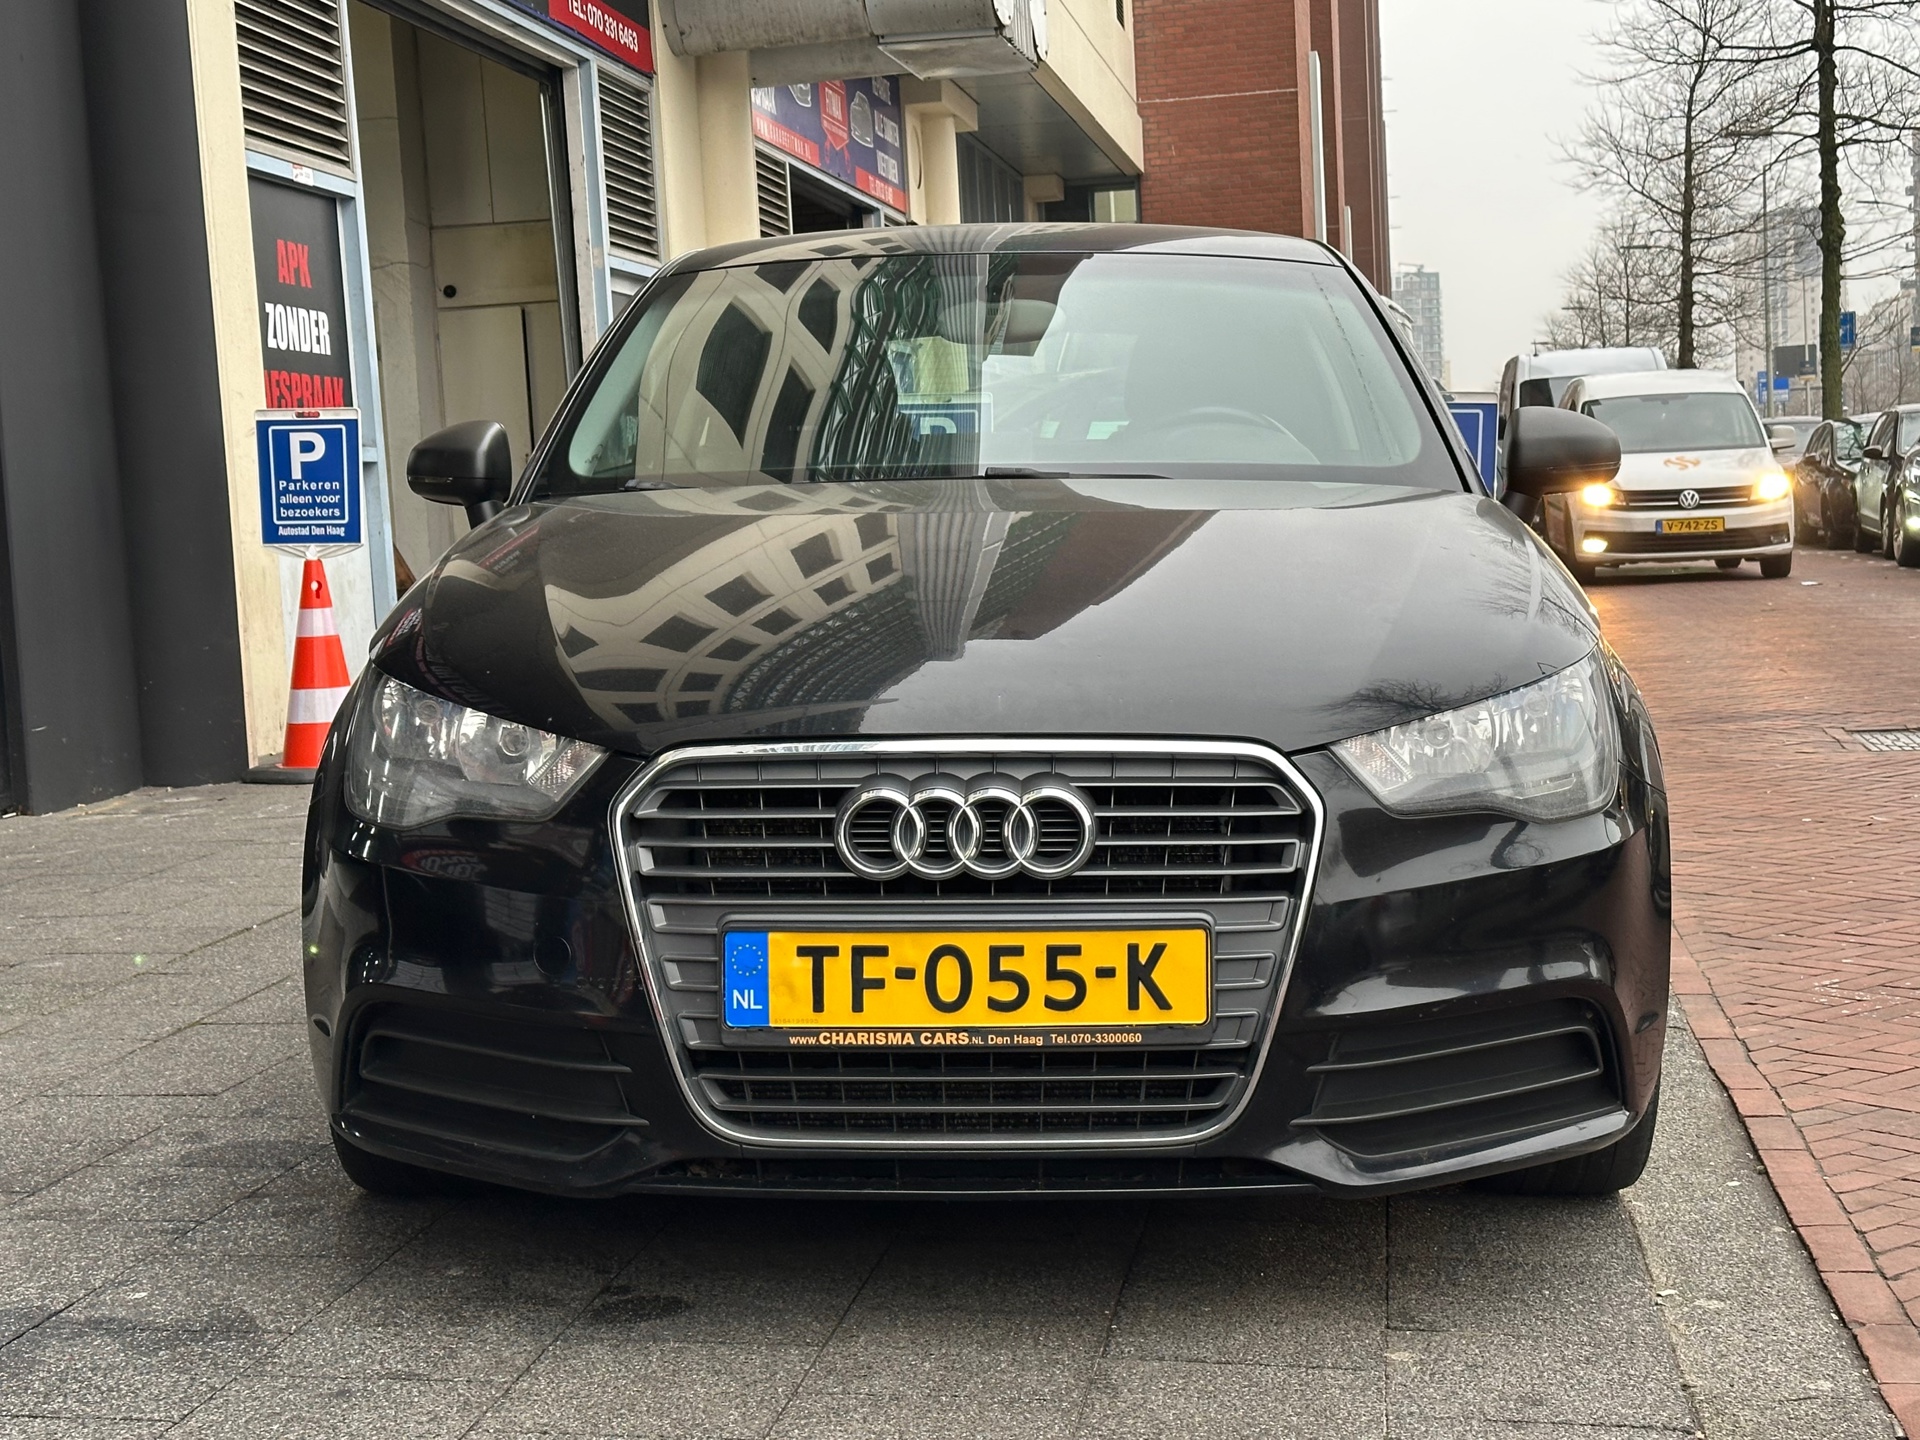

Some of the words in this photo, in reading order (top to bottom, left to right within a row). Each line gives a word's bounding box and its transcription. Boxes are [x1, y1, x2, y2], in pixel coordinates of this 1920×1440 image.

[587, 2, 603, 32] 070
[604, 13, 618, 41] 331
[618, 22, 638, 53] 6463
[276, 239, 312, 288] APK
[265, 302, 331, 355] ZONDER
[289, 432, 326, 480] P
[279, 480, 340, 491] Parkeren
[280, 494, 312, 504] alleen
[314, 495, 340, 503] voor
[280, 507, 340, 517] bezoekers
[278, 526, 310, 536] Autostad
[311, 526, 325, 535] Den
[326, 526, 345, 537] Haag
[1666, 519, 1718, 532] V-742-ZS
[796, 943, 1173, 1014] TF-055-K
[732, 989, 763, 1010] NL
[987, 1034, 1011, 1045] Den
[1013, 1034, 1043, 1047] Haag
[1050, 1032, 1142, 1045] Tel.070-3300060
